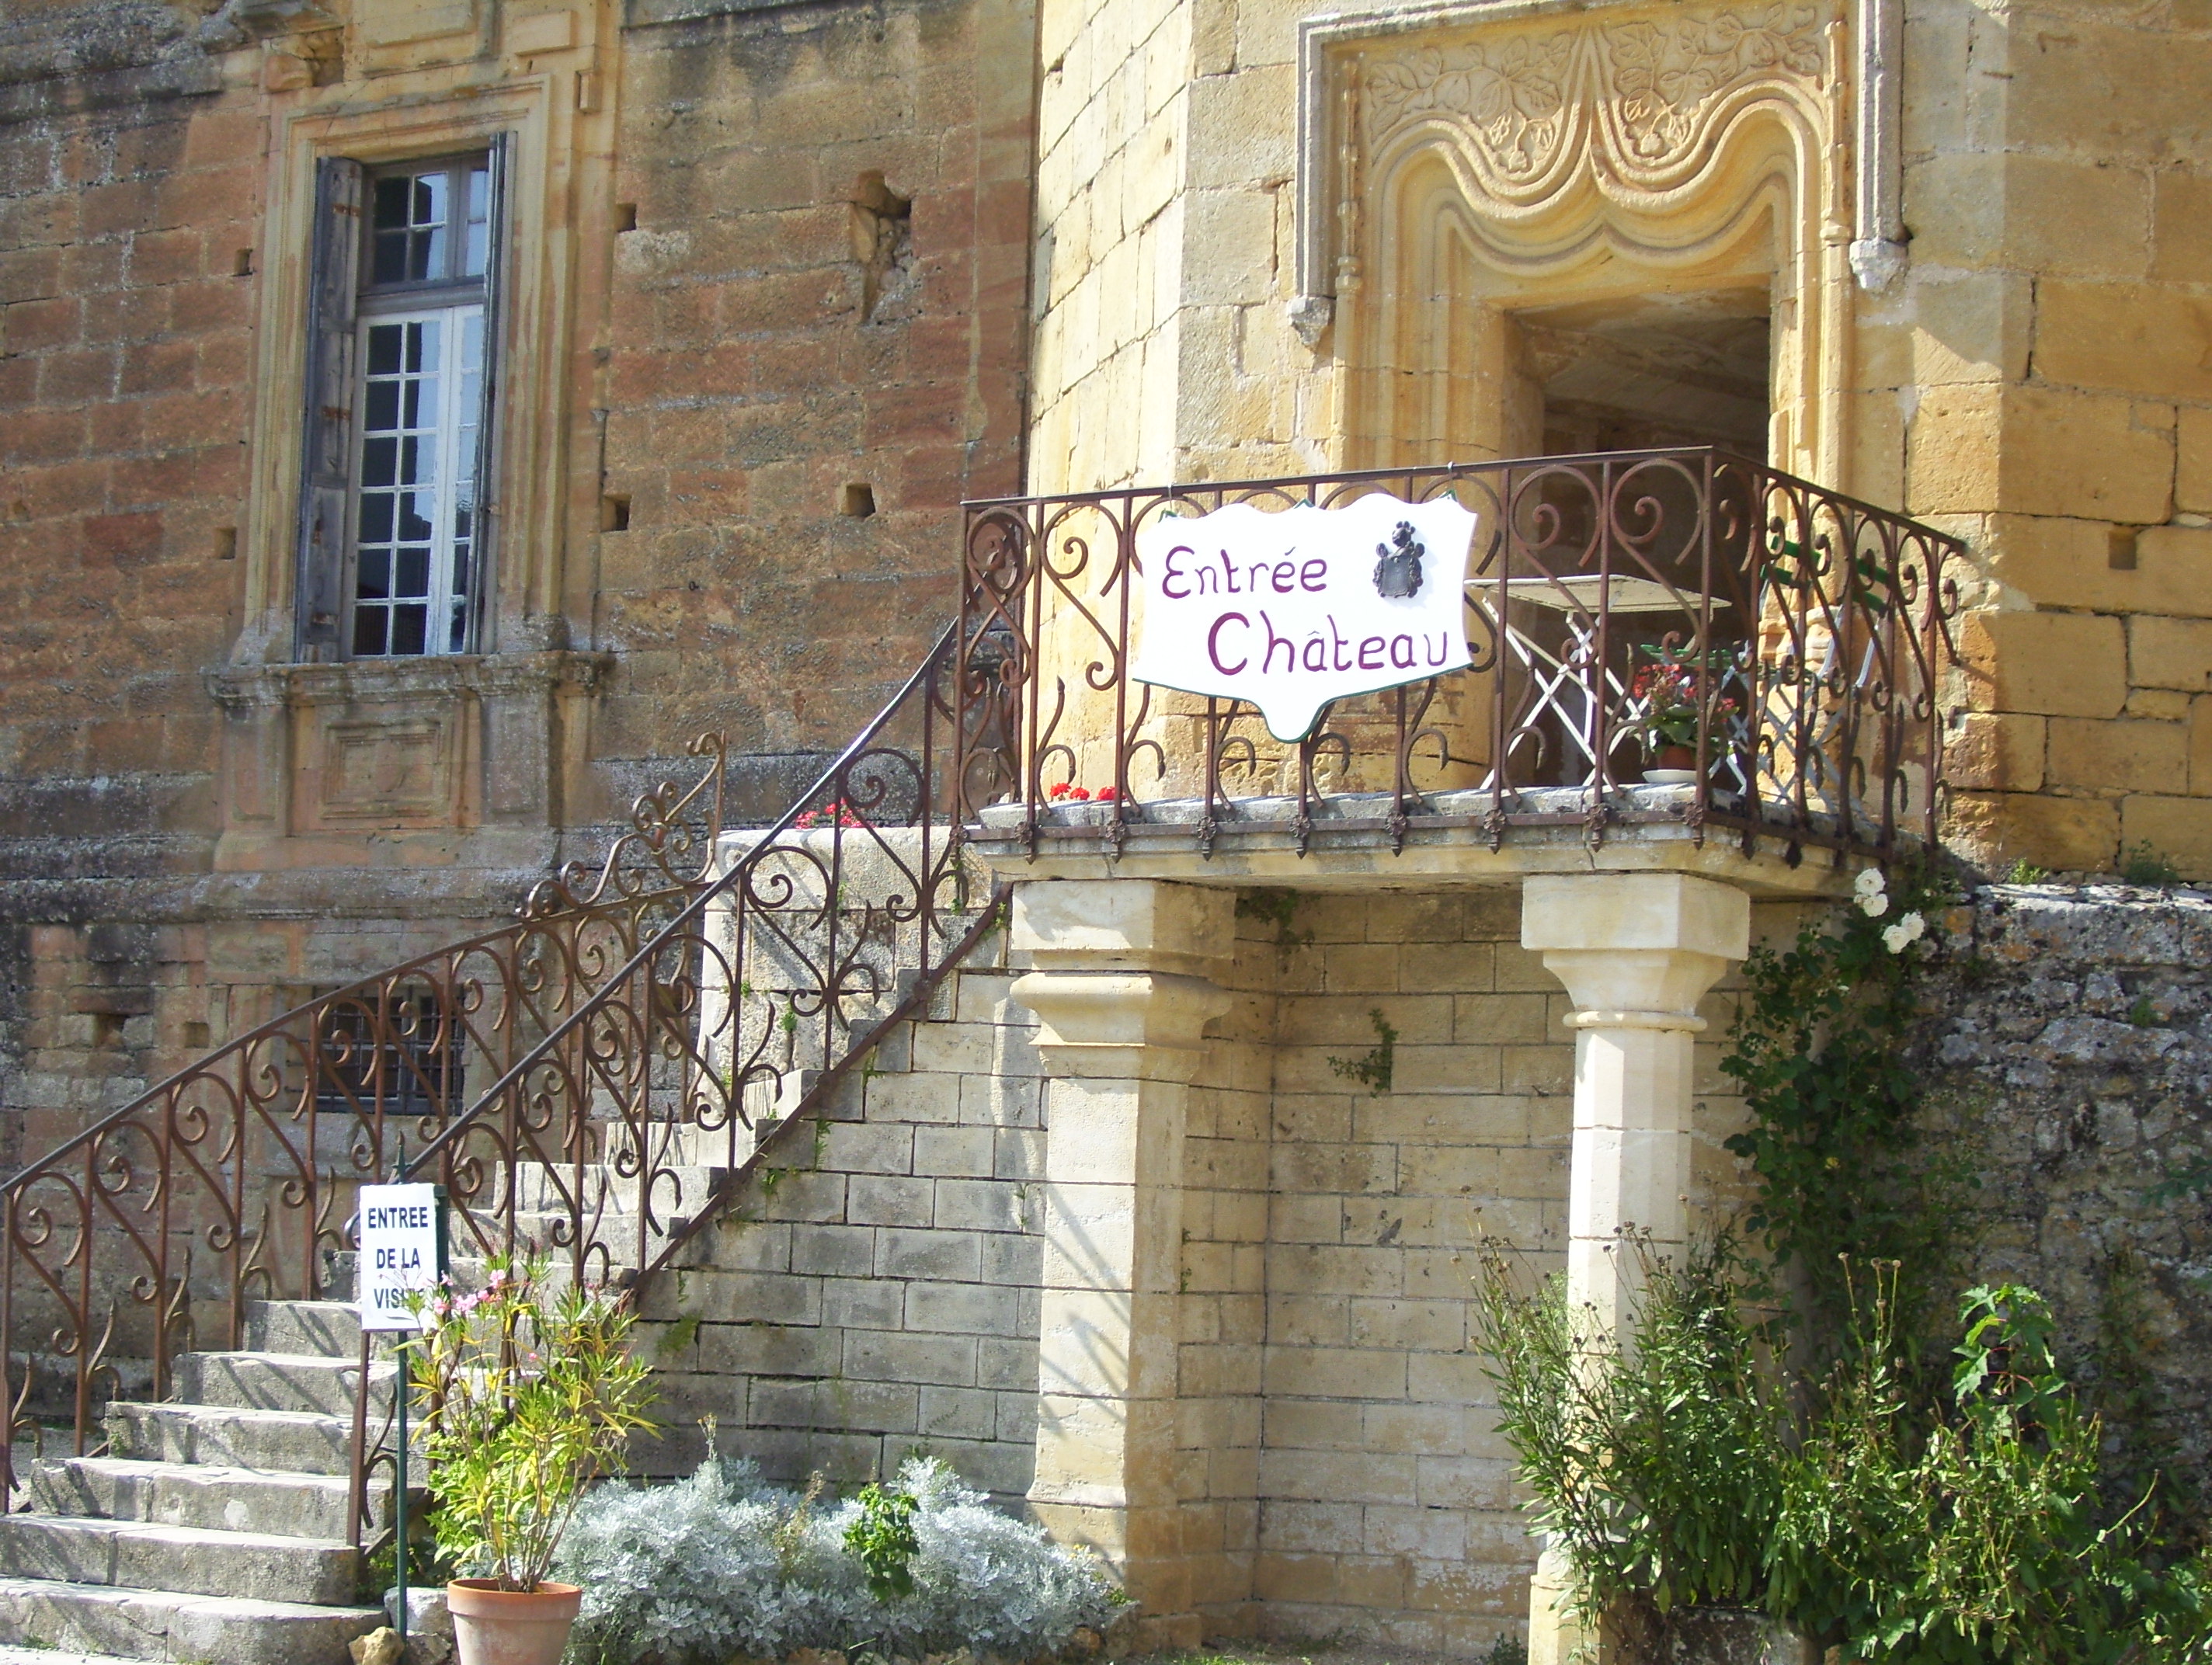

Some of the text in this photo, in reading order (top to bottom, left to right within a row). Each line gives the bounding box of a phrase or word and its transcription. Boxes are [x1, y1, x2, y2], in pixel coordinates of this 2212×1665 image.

[1162, 546, 1327, 599] Entrée
[1209, 610, 1448, 676] Château
[368, 1207, 428, 1229] ENTREE
[376, 1247, 421, 1269] DE LA
[374, 1288, 426, 1309] VISI
